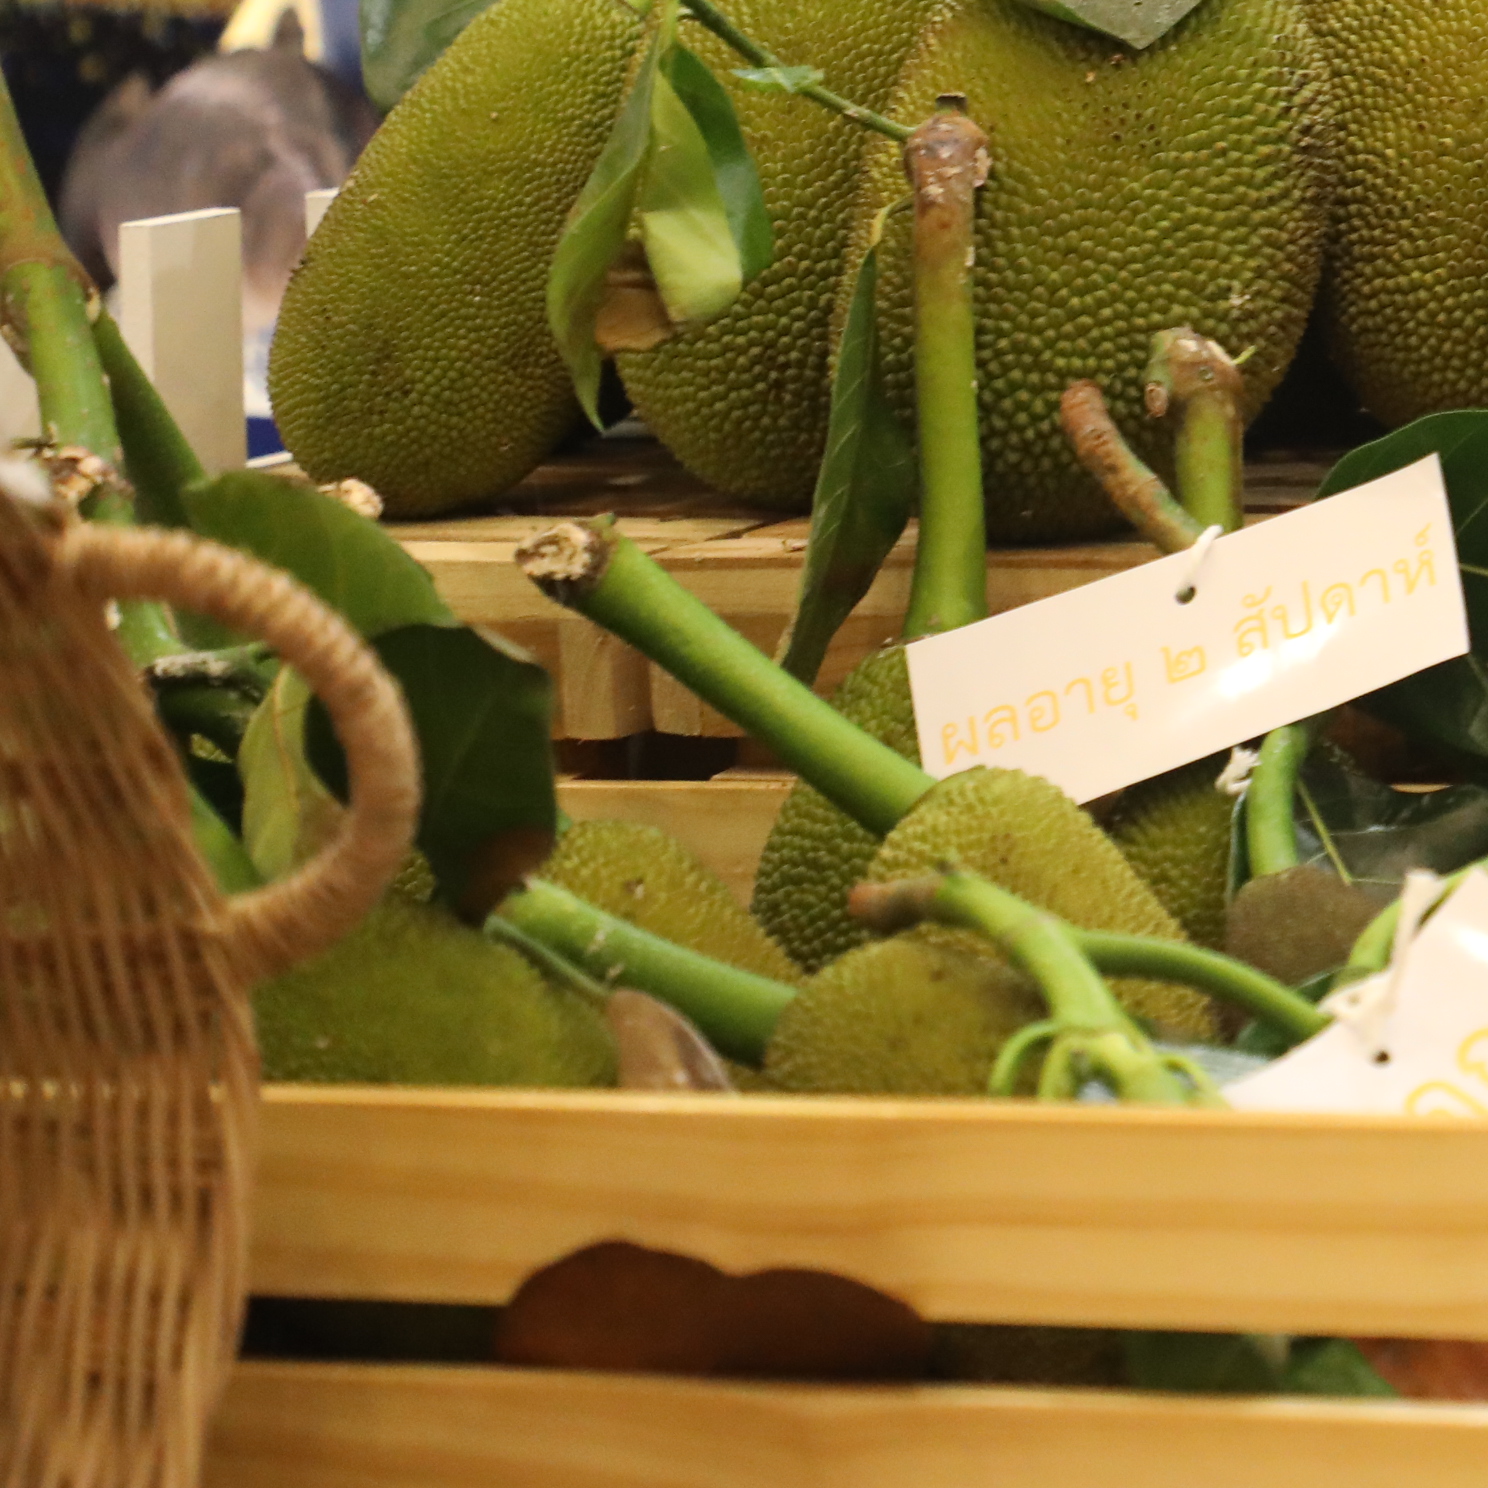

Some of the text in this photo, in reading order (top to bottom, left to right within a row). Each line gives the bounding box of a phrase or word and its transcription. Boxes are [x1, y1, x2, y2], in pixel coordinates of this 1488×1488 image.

[940, 520, 1439, 766] ผลอายุ ๒ สัปดาห์
